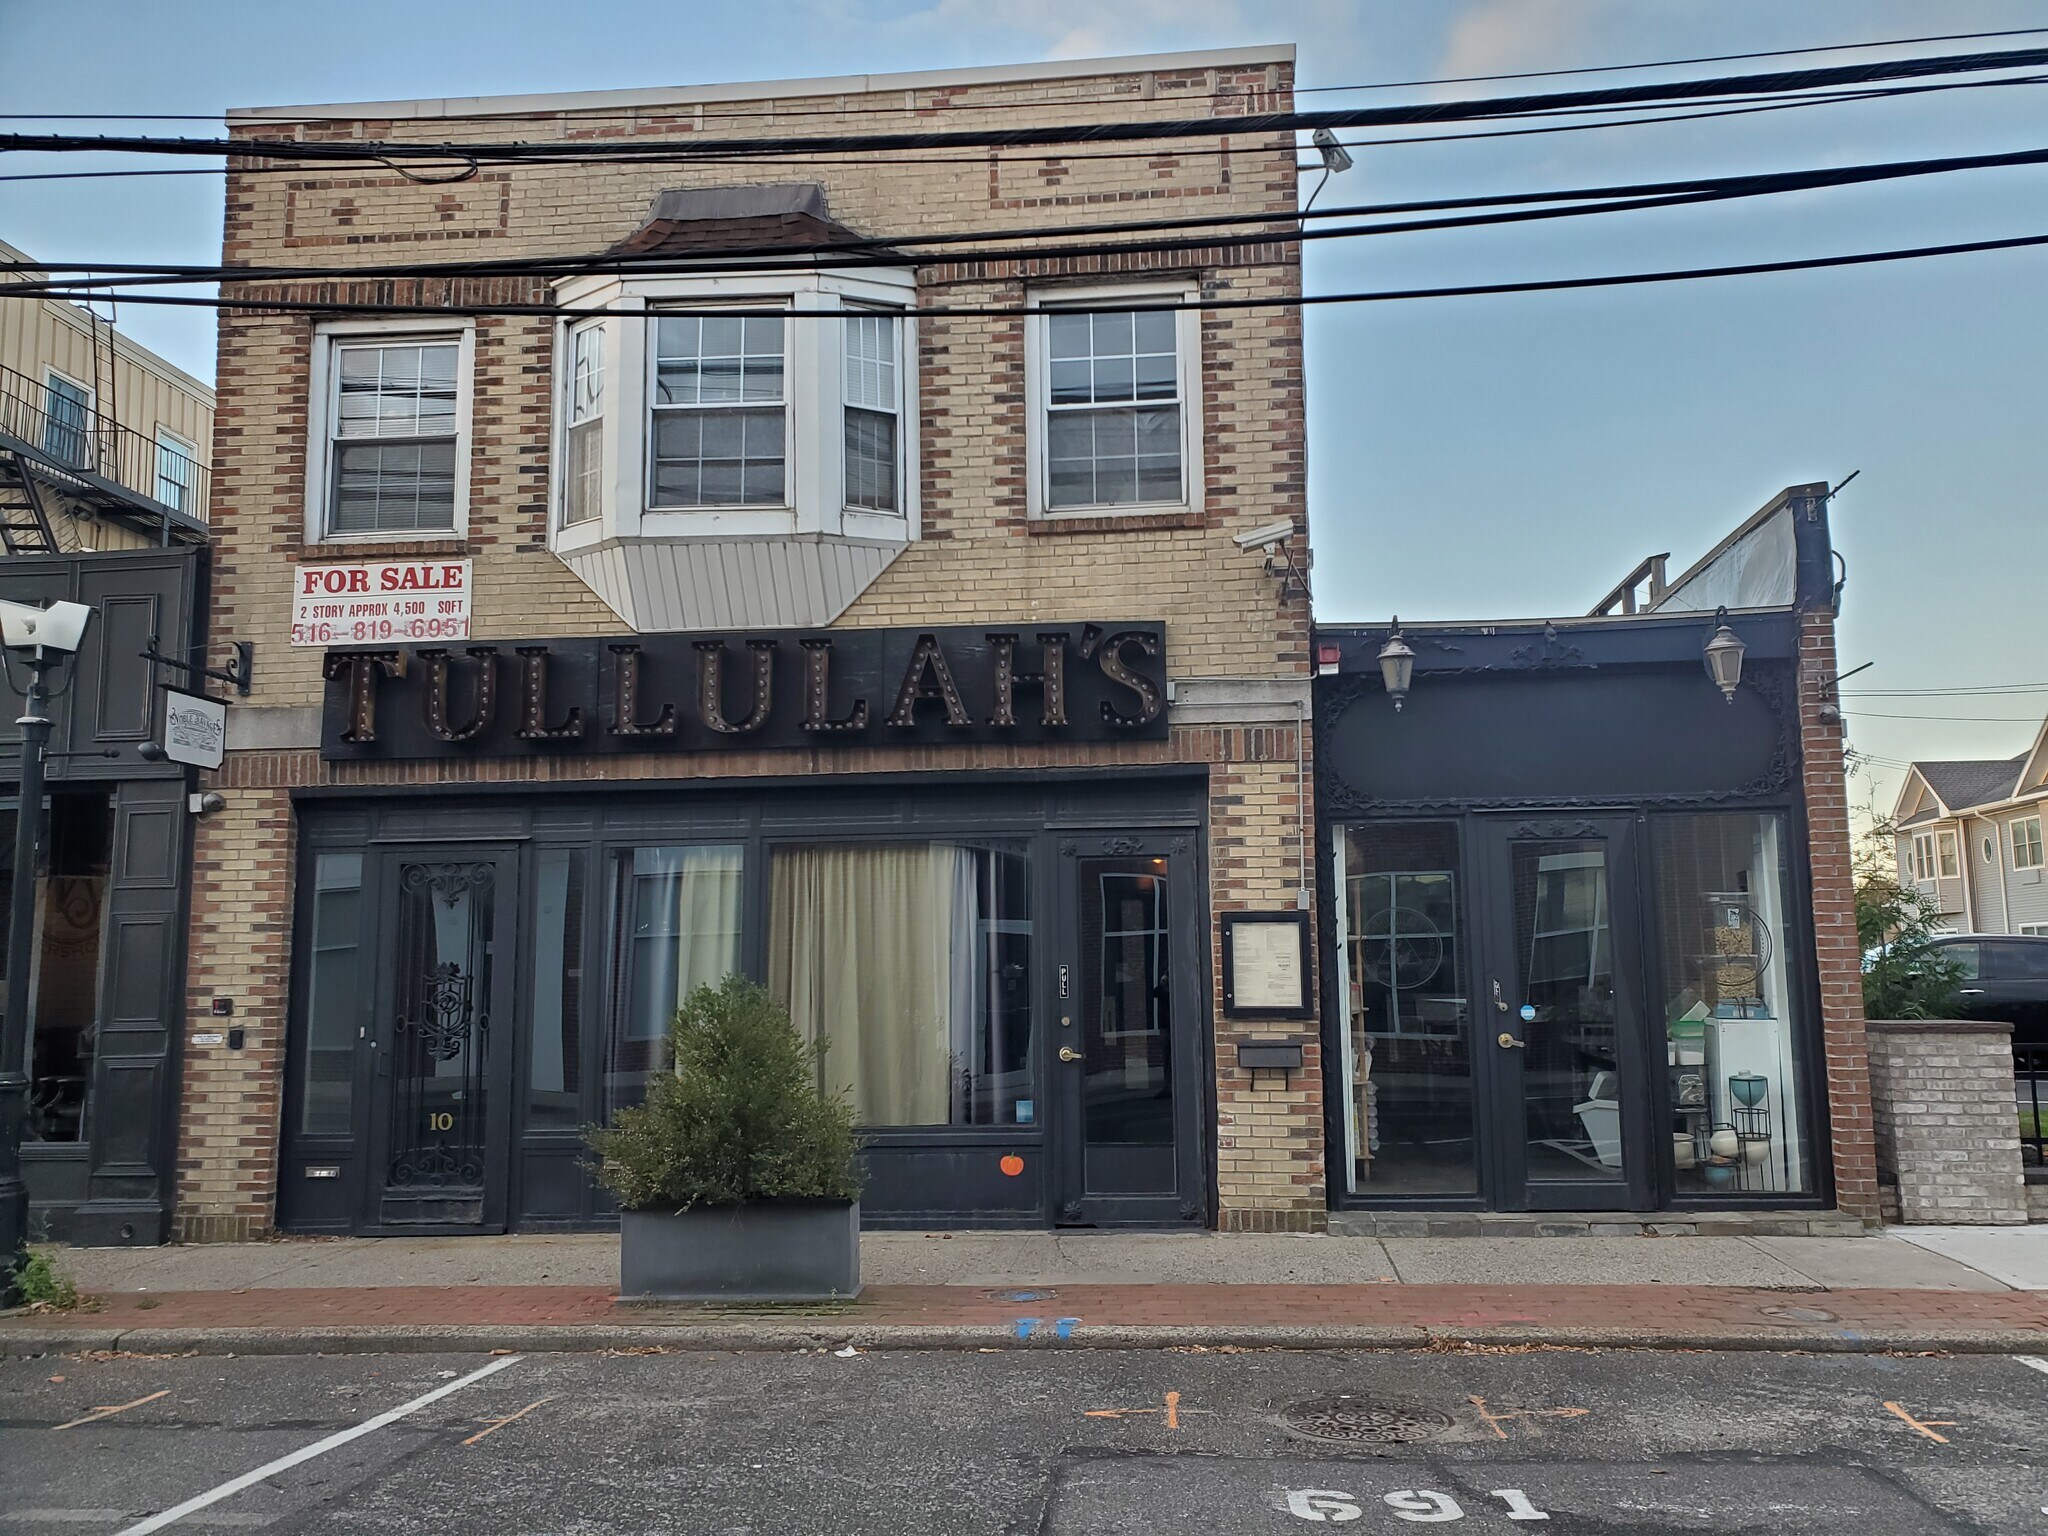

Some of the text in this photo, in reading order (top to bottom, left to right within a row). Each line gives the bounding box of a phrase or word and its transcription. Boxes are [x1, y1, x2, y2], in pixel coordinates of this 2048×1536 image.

[302, 565, 463, 594] FOR SALE
[300, 600, 463, 619] 2 STORY APPROX 4,500 SQFT
[322, 623, 1161, 743] TULLULAH'S
[429, 1112, 454, 1131] 10
[1287, 1489, 1551, 1522] 691
